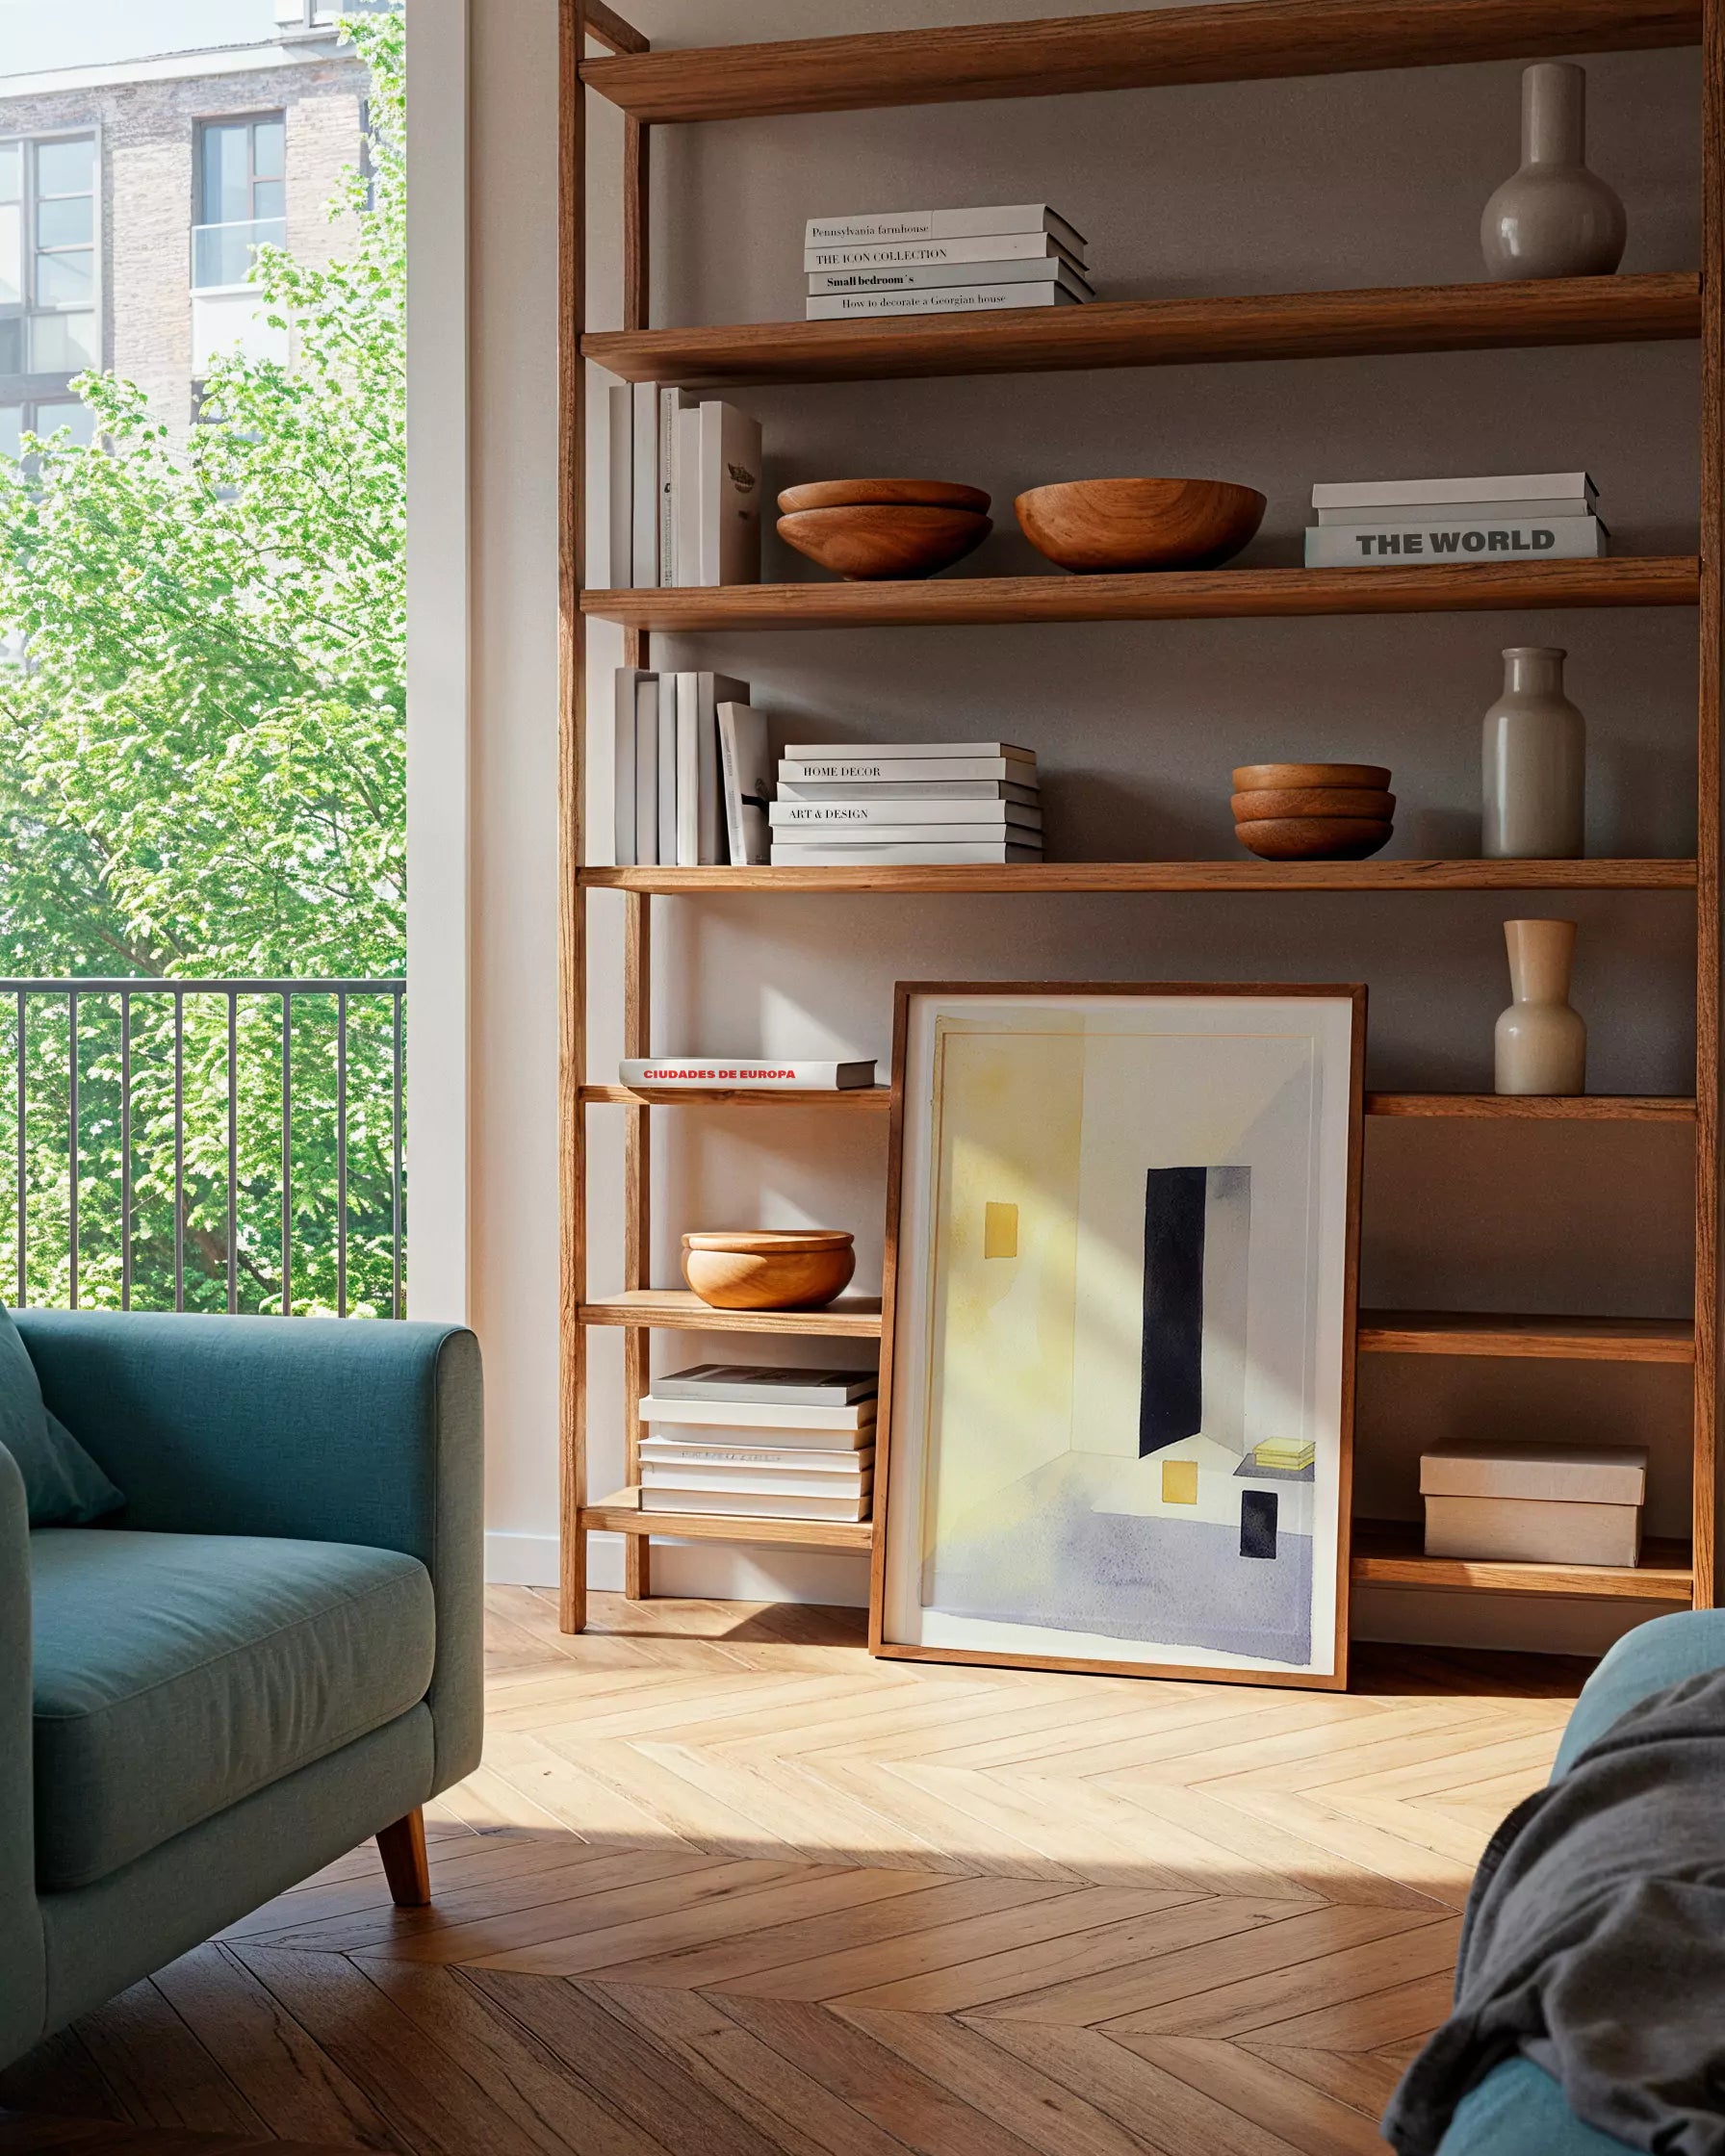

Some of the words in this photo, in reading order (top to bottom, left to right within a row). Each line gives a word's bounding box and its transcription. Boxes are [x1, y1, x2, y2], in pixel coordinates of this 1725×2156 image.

[811, 225, 875, 240] Pennsylvania
[878, 223, 929, 236] farmhouse
[816, 254, 840, 265] THE
[843, 252, 870, 264] ICON
[873, 248, 947, 263] COLLECTION
[827, 275, 857, 287] Small
[841, 298, 865, 309] How
[868, 298, 878, 307] to
[880, 296, 920, 307] decorate
[931, 295, 975, 307] Georgian
[977, 294, 1007, 304] house
[1355, 534, 1423, 555] THE
[1429, 529, 1556, 553] WORLD
[804, 767, 838, 777] HOME
[841, 767, 882, 777] DECOR
[788, 809, 812, 819] ART
[814, 809, 822, 819] &
[825, 808, 868, 819] DESIGN
[643, 1069, 715, 1079] CIUDADES
[718, 1069, 737, 1079] DE
[739, 1069, 796, 1079] EUROPA
